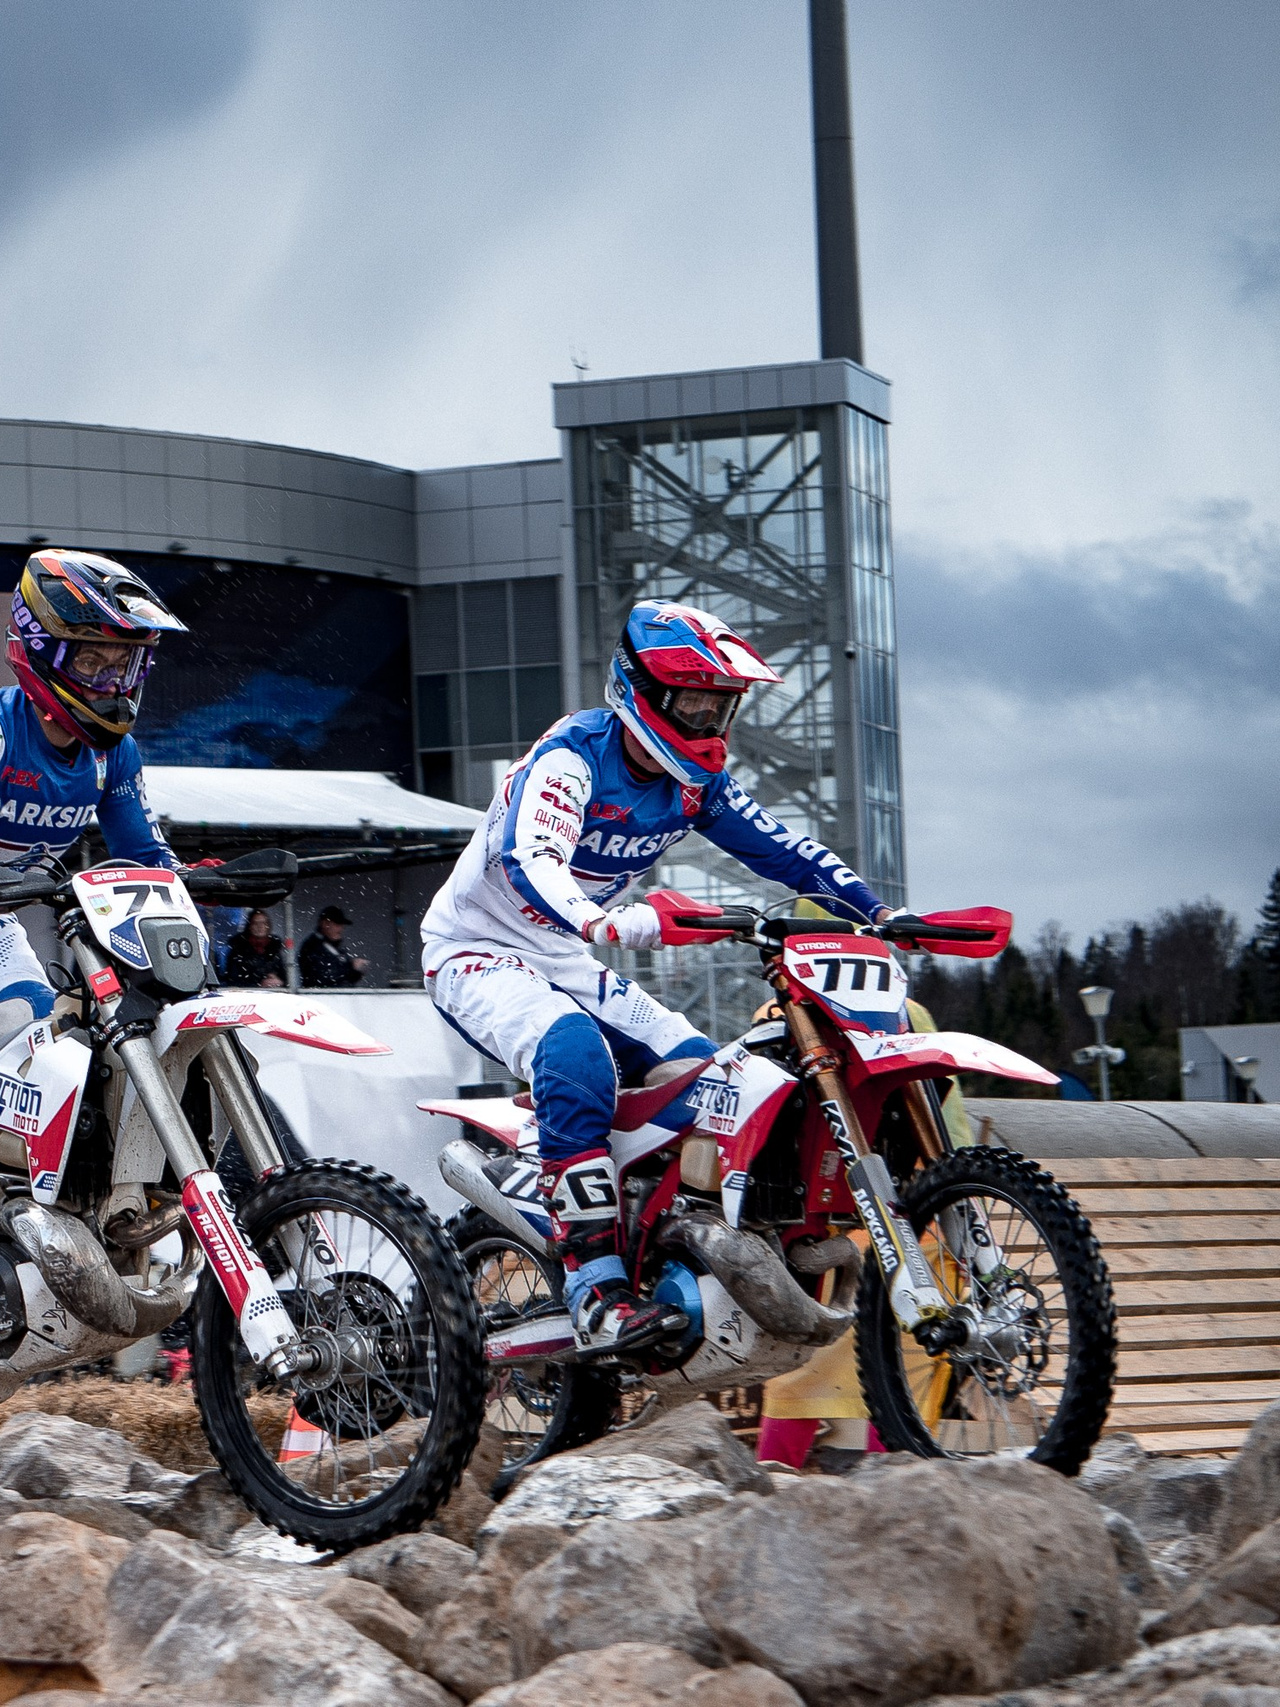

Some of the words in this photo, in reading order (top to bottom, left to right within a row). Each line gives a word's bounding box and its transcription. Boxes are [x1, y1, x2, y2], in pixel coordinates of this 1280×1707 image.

[591, 803, 632, 824] LEX
[92, 871, 127, 882] SHISHA
[113, 885, 176, 917] 71
[814, 958, 890, 992] 777
[209, 1004, 256, 1018] ACTION
[12, 1113, 39, 1133] MOTO
[565, 1167, 618, 1211] G
[197, 1213, 238, 1273] ACTION
[852, 1187, 899, 1274] ДАРКСАЙД
